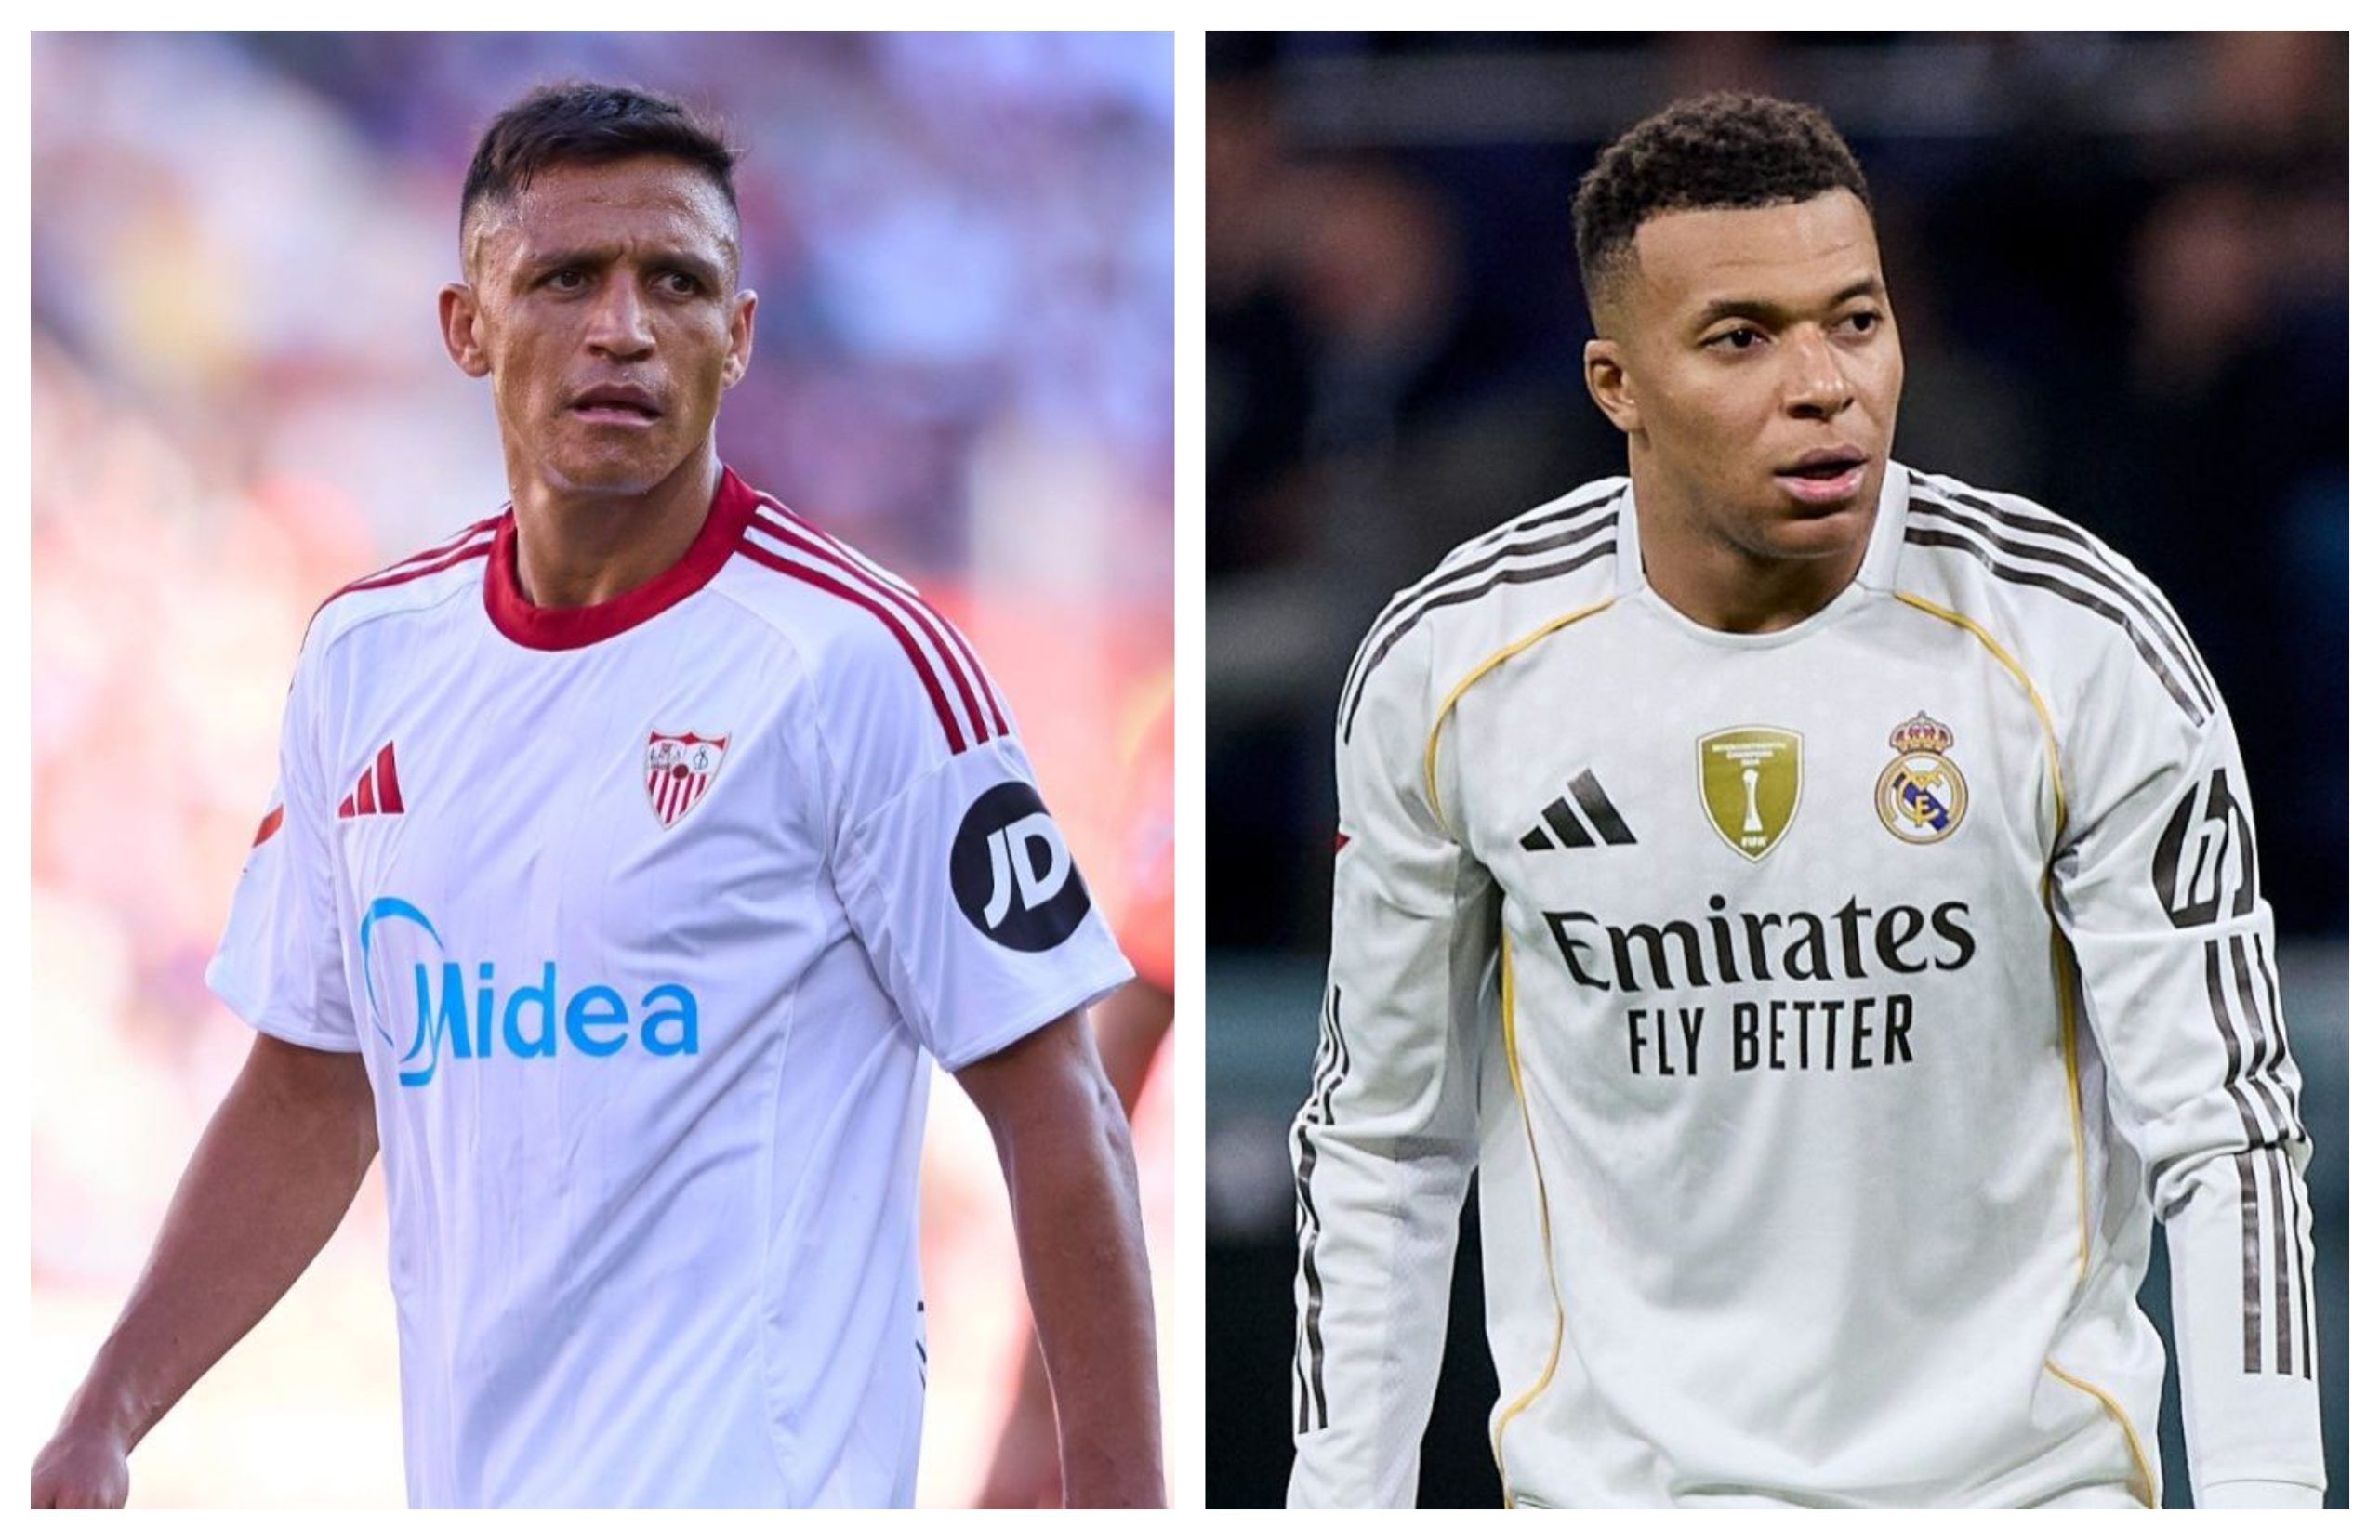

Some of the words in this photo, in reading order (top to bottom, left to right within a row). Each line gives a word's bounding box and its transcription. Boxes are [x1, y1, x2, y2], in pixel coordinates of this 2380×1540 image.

[984, 811, 1072, 930] JD
[1542, 894, 1976, 993] Emirates
[398, 960, 699, 1086] Midea
[1627, 1007, 1704, 1075] FLY
[1732, 994, 1913, 1072] BETTER
